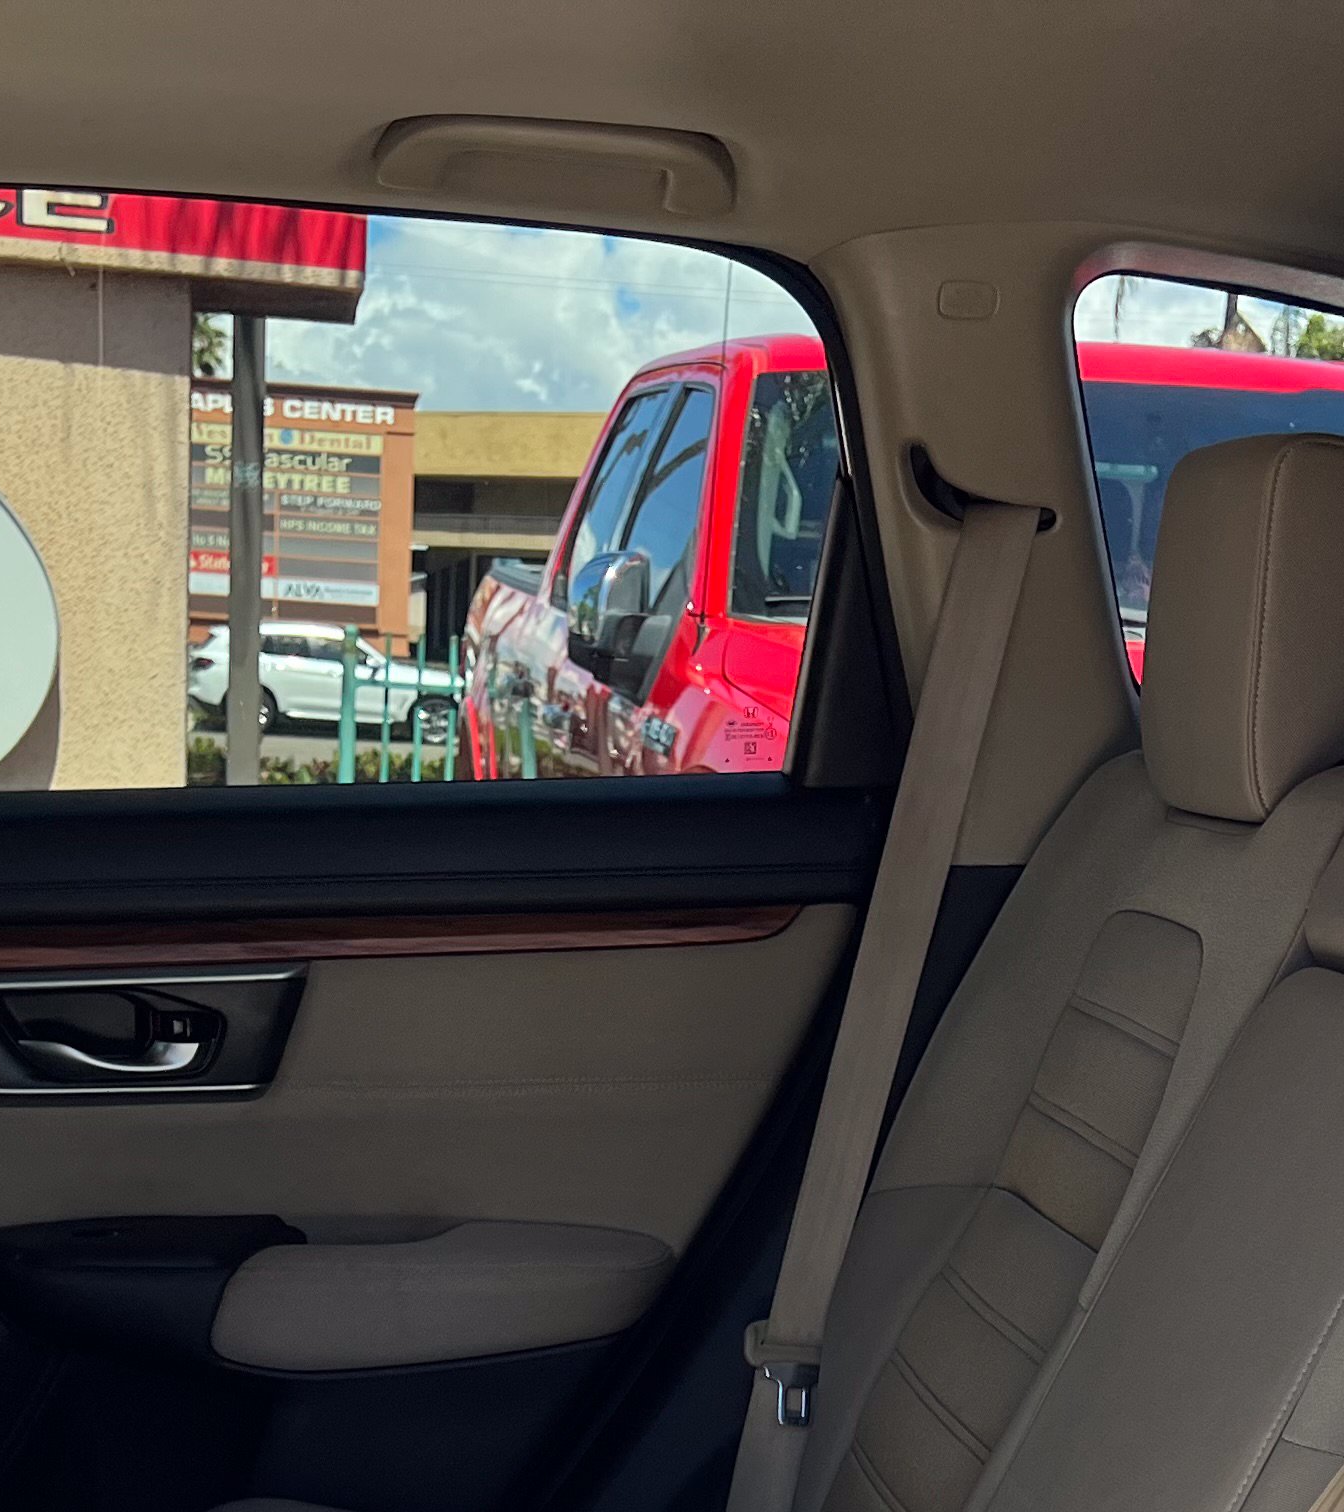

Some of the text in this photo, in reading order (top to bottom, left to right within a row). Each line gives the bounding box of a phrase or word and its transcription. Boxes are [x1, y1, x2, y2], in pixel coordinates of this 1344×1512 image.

[282, 399, 396, 426] CENTER
[299, 432, 372, 451] Dental
[206, 466, 352, 494] MEYTREE
